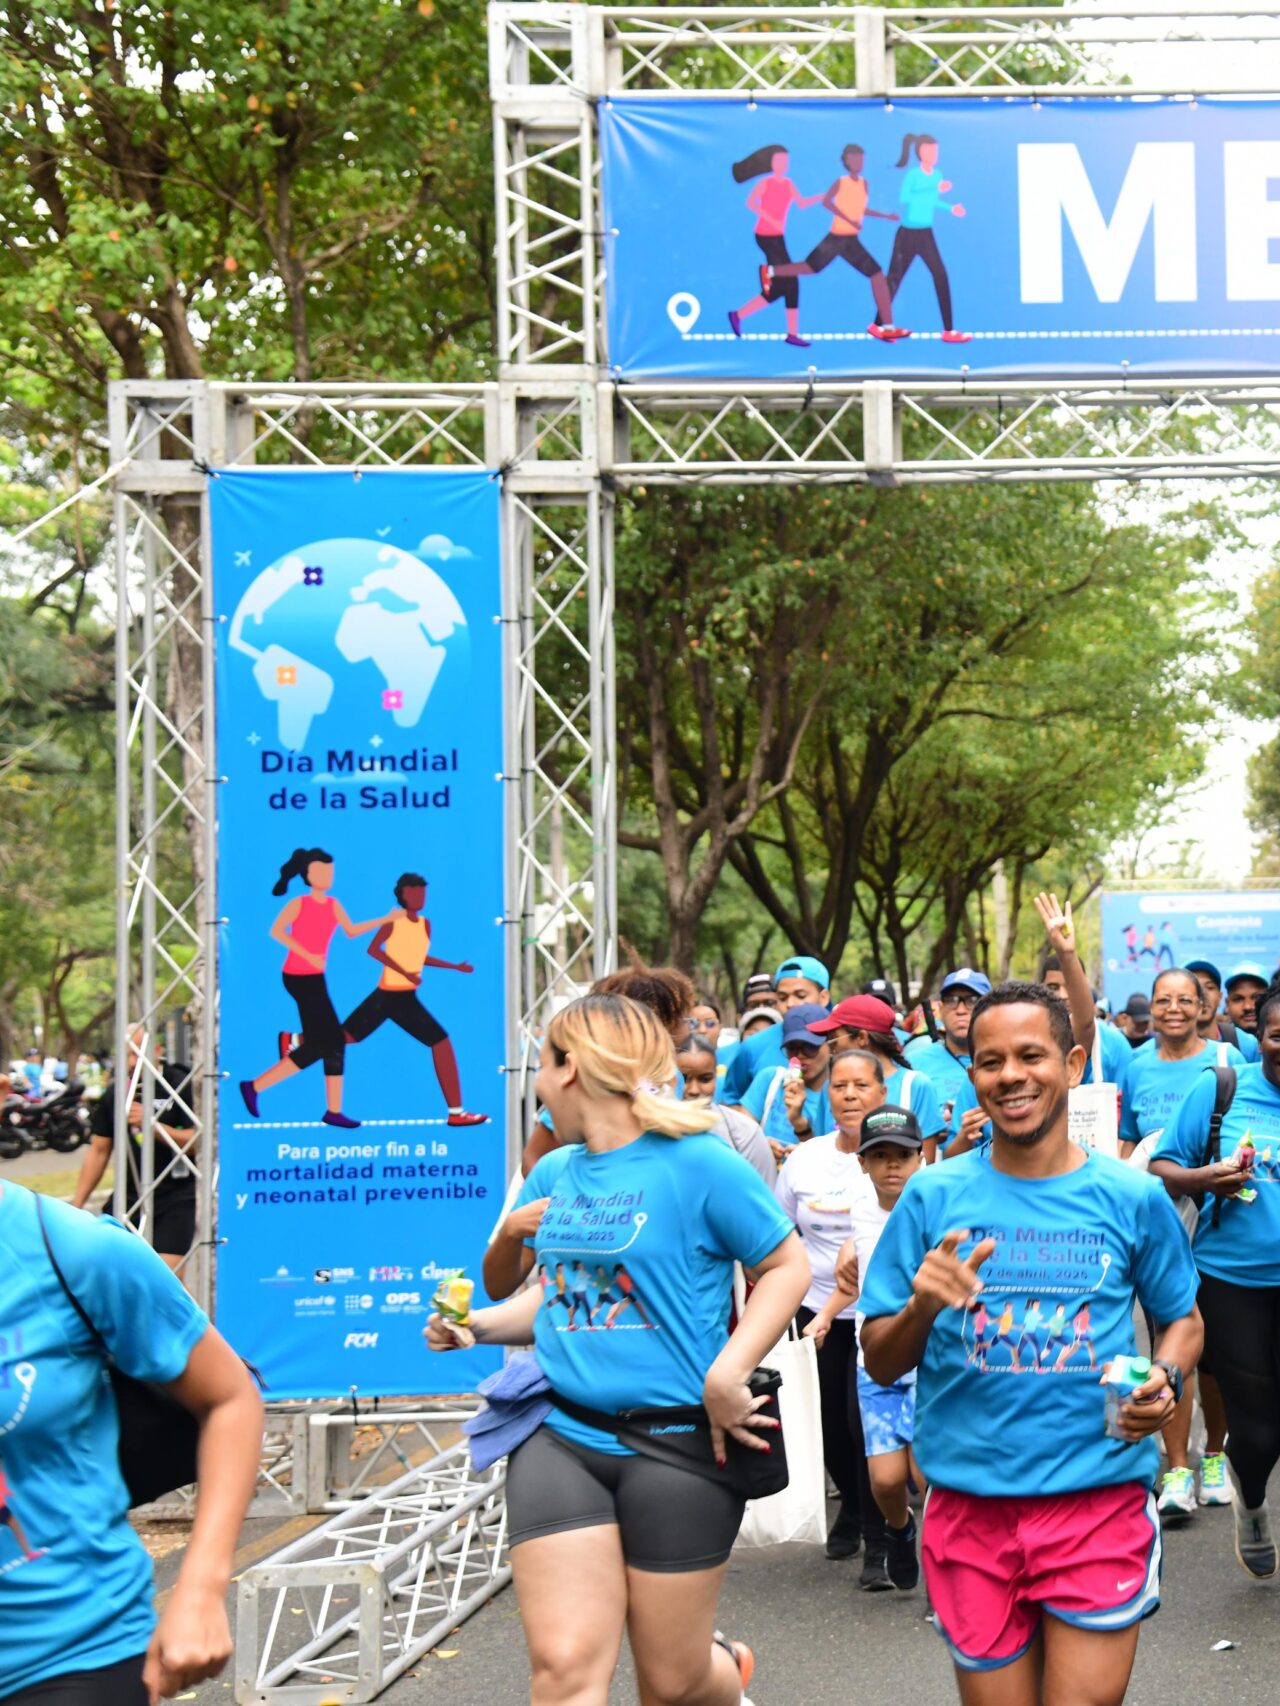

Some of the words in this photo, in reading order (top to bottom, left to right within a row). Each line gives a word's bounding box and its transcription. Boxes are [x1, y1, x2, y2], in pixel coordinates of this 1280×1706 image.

[261, 750, 313, 773] Día
[327, 748, 458, 773] Mundial
[269, 787, 308, 809] de
[320, 787, 347, 808] la
[359, 786, 451, 809] Salud
[277, 1143, 320, 1159] Para
[325, 1143, 381, 1161] poner
[386, 1140, 409, 1157] fin
[415, 1145, 426, 1156] a
[431, 1140, 448, 1156] la
[247, 1163, 374, 1181] mortalidad
[382, 1163, 479, 1178] materna
[236, 1193, 248, 1209] y
[254, 1185, 356, 1204] neonatal
[365, 1181, 487, 1205] prevenible
[571, 1189, 644, 1210] Mundial
[558, 1211, 573, 1225] la
[580, 1209, 632, 1226] Salud
[587, 1231, 617, 1241] 2025
[1015, 1226, 1106, 1247] Mundial
[1009, 1248, 1028, 1264] la
[1037, 1248, 1100, 1267] Salud
[986, 1269, 993, 1280] 7
[996, 1268, 1012, 1280] de
[1055, 1269, 1088, 1280] 2025
[294, 1295, 323, 1308] unicef
[385, 1292, 421, 1305] OPS
[344, 1332, 379, 1348] FCM
